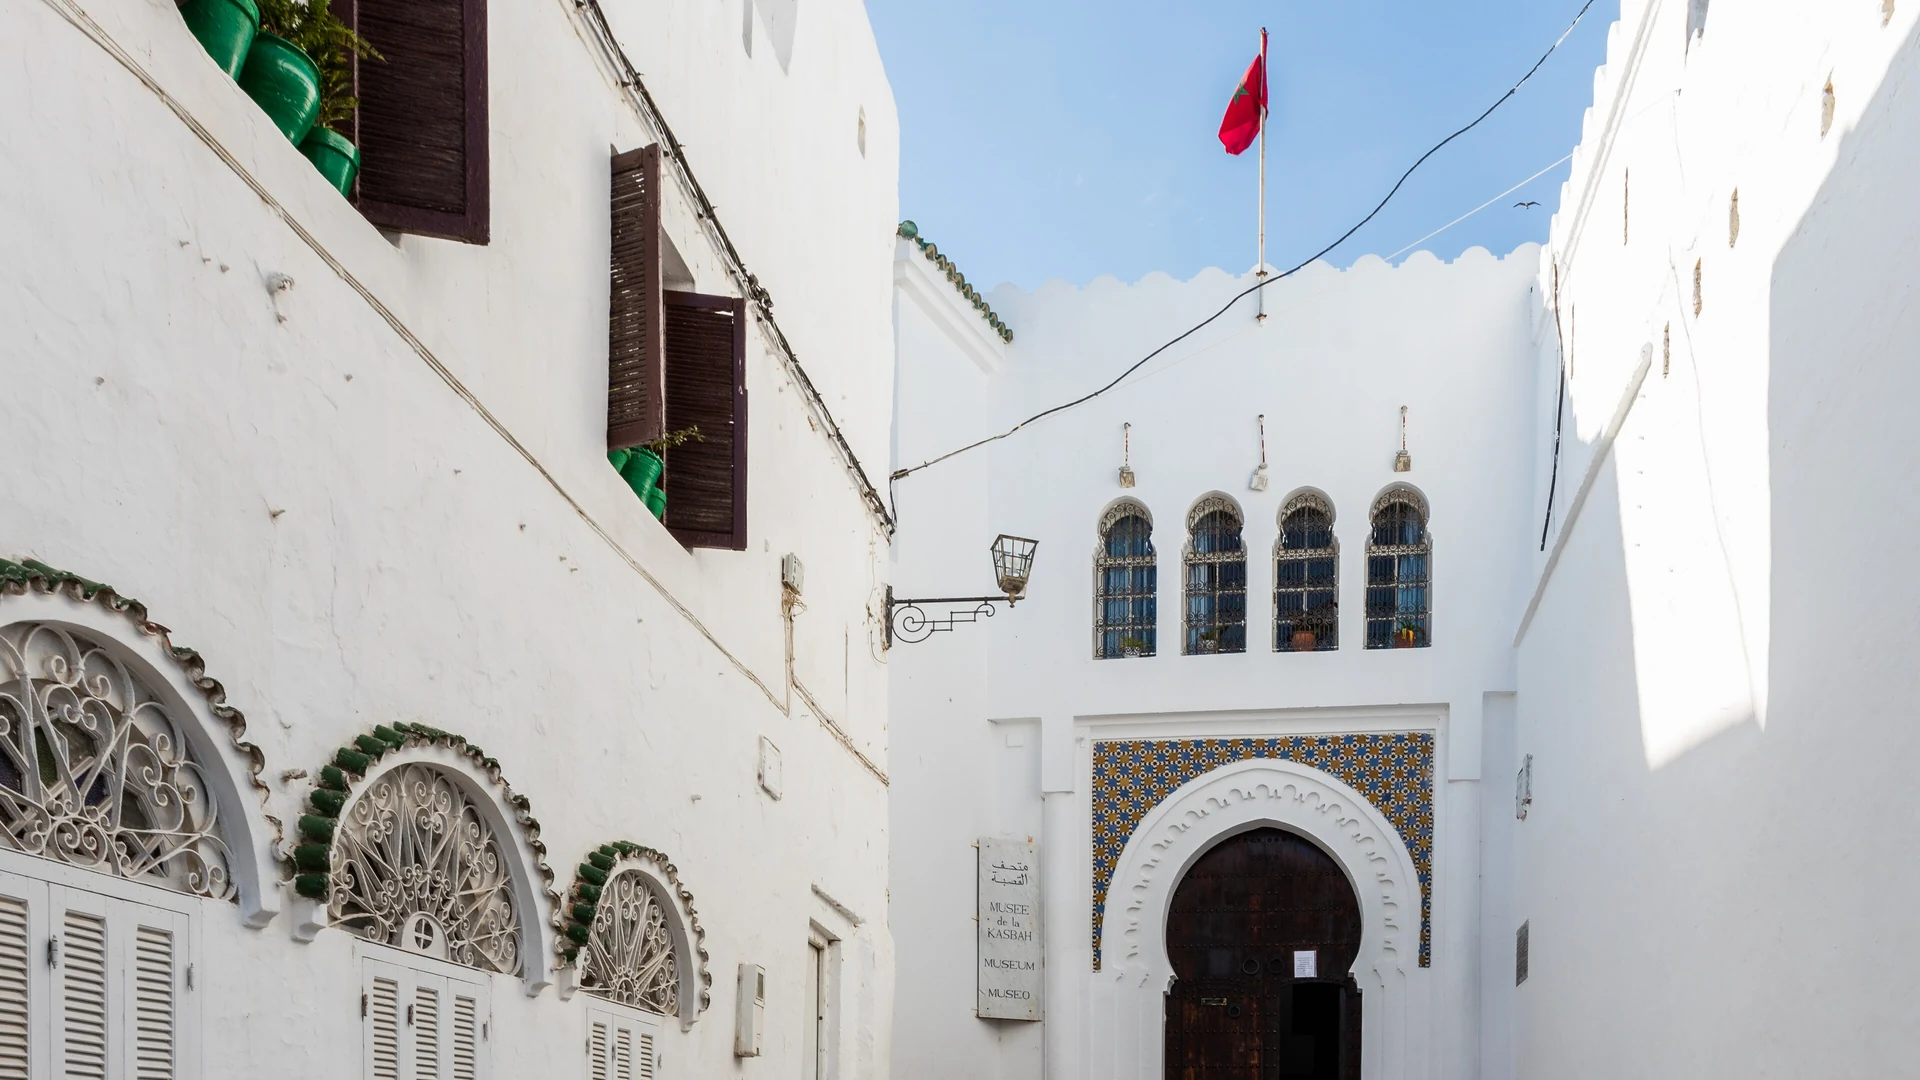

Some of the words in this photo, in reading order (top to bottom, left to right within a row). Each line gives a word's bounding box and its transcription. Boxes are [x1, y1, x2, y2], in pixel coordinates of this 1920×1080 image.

[991, 860, 1029, 871] متحف
[991, 871, 1028, 886] القصبة
[989, 901, 1030, 916] MUSEE
[996, 916, 1008, 927] de
[1011, 917, 1020, 928] la
[987, 927, 1032, 942] KASBAH
[984, 958, 1035, 971] MUSEUM
[988, 988, 1031, 1000] MUSEO
